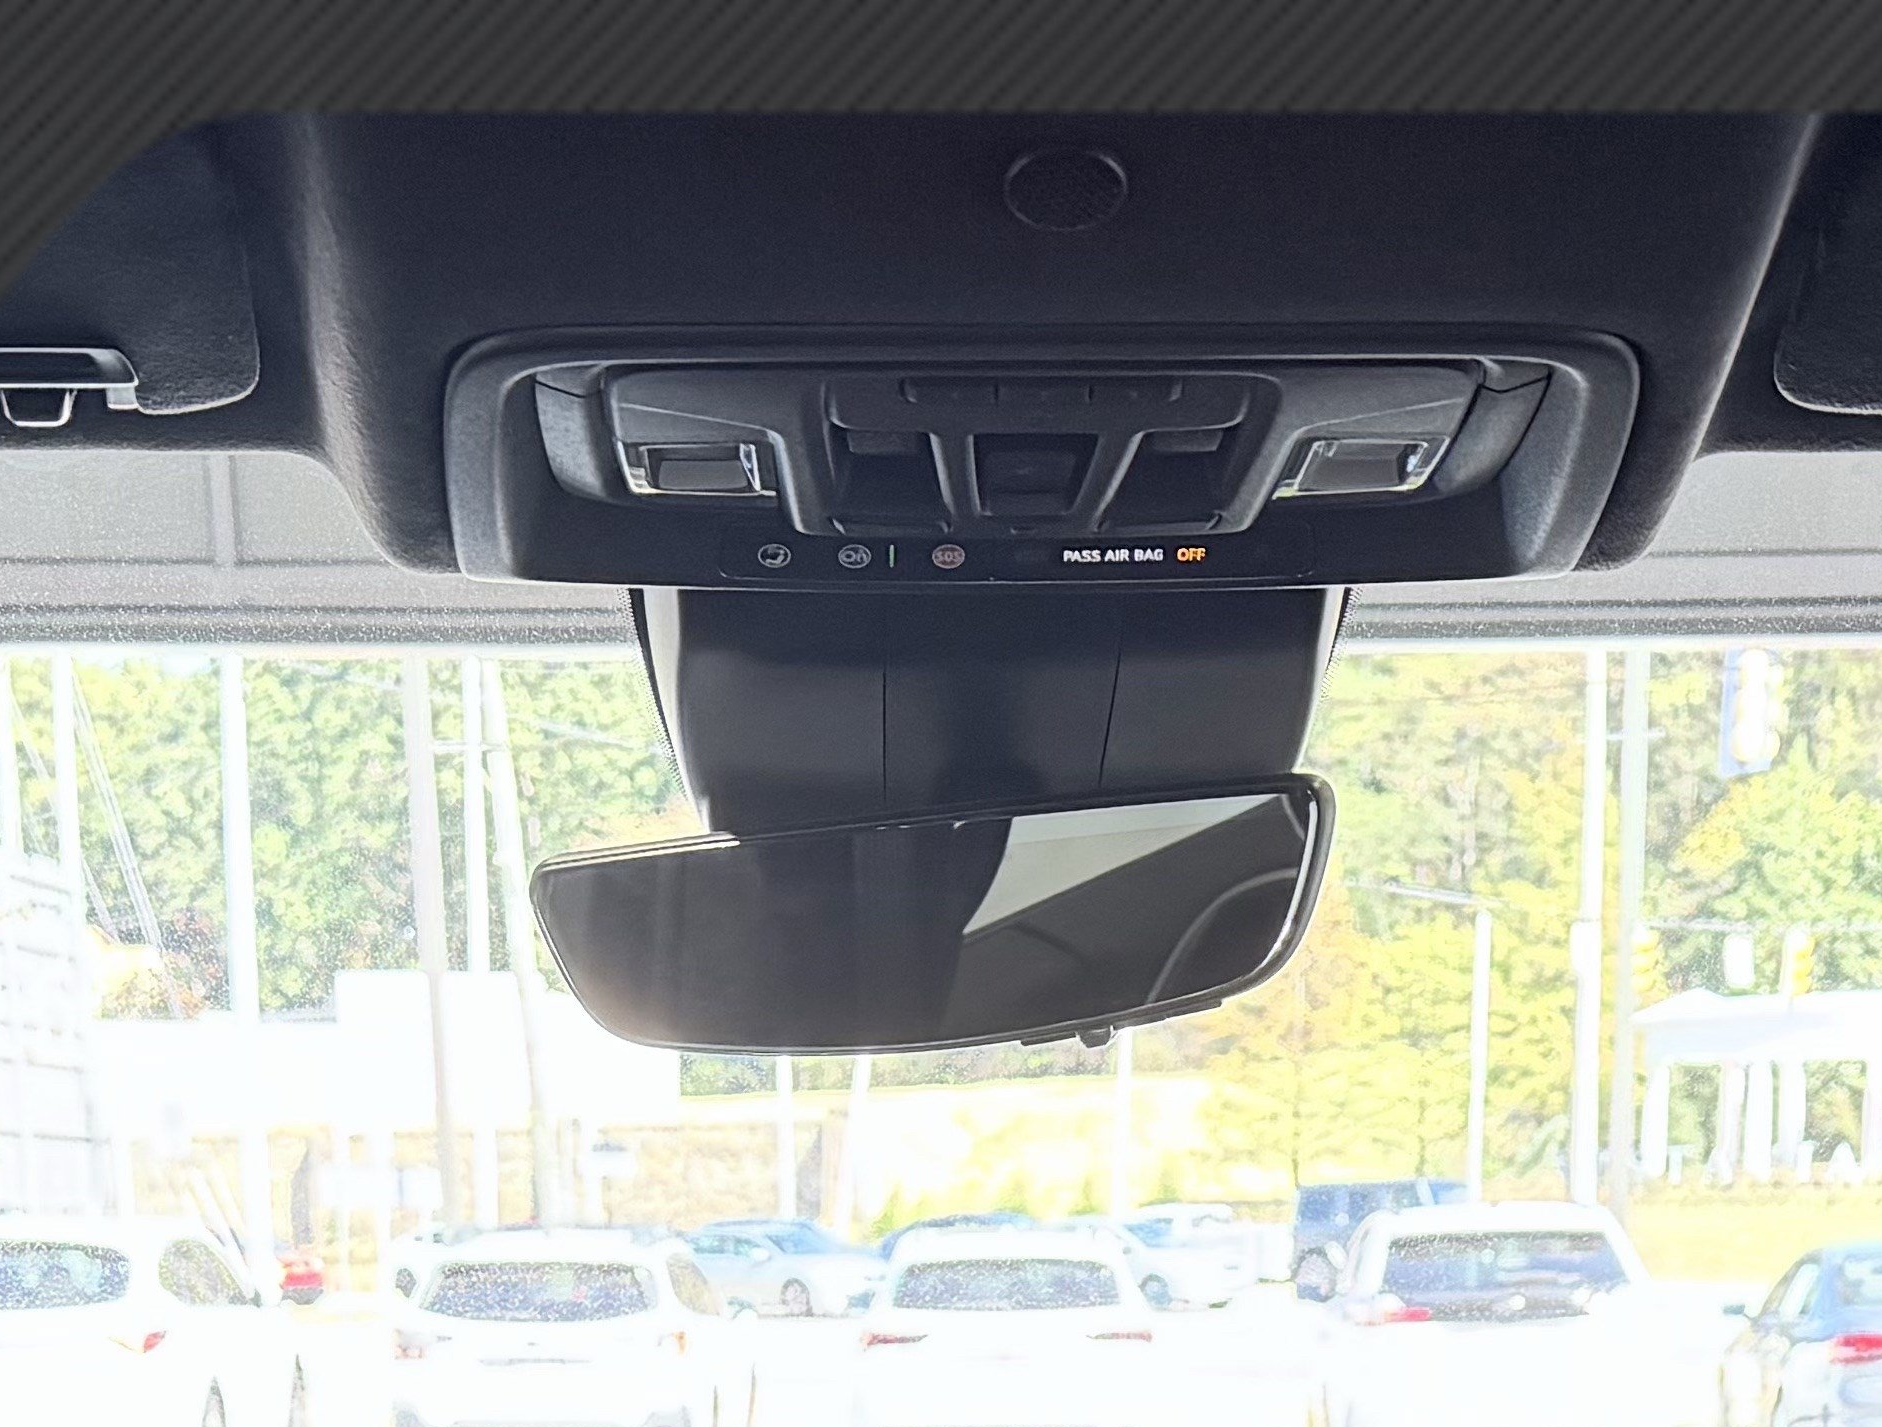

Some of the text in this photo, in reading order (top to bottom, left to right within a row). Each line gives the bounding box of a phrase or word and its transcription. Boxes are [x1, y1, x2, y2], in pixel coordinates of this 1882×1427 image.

[1063, 547, 1206, 563] PASS AIR BAG OFF
